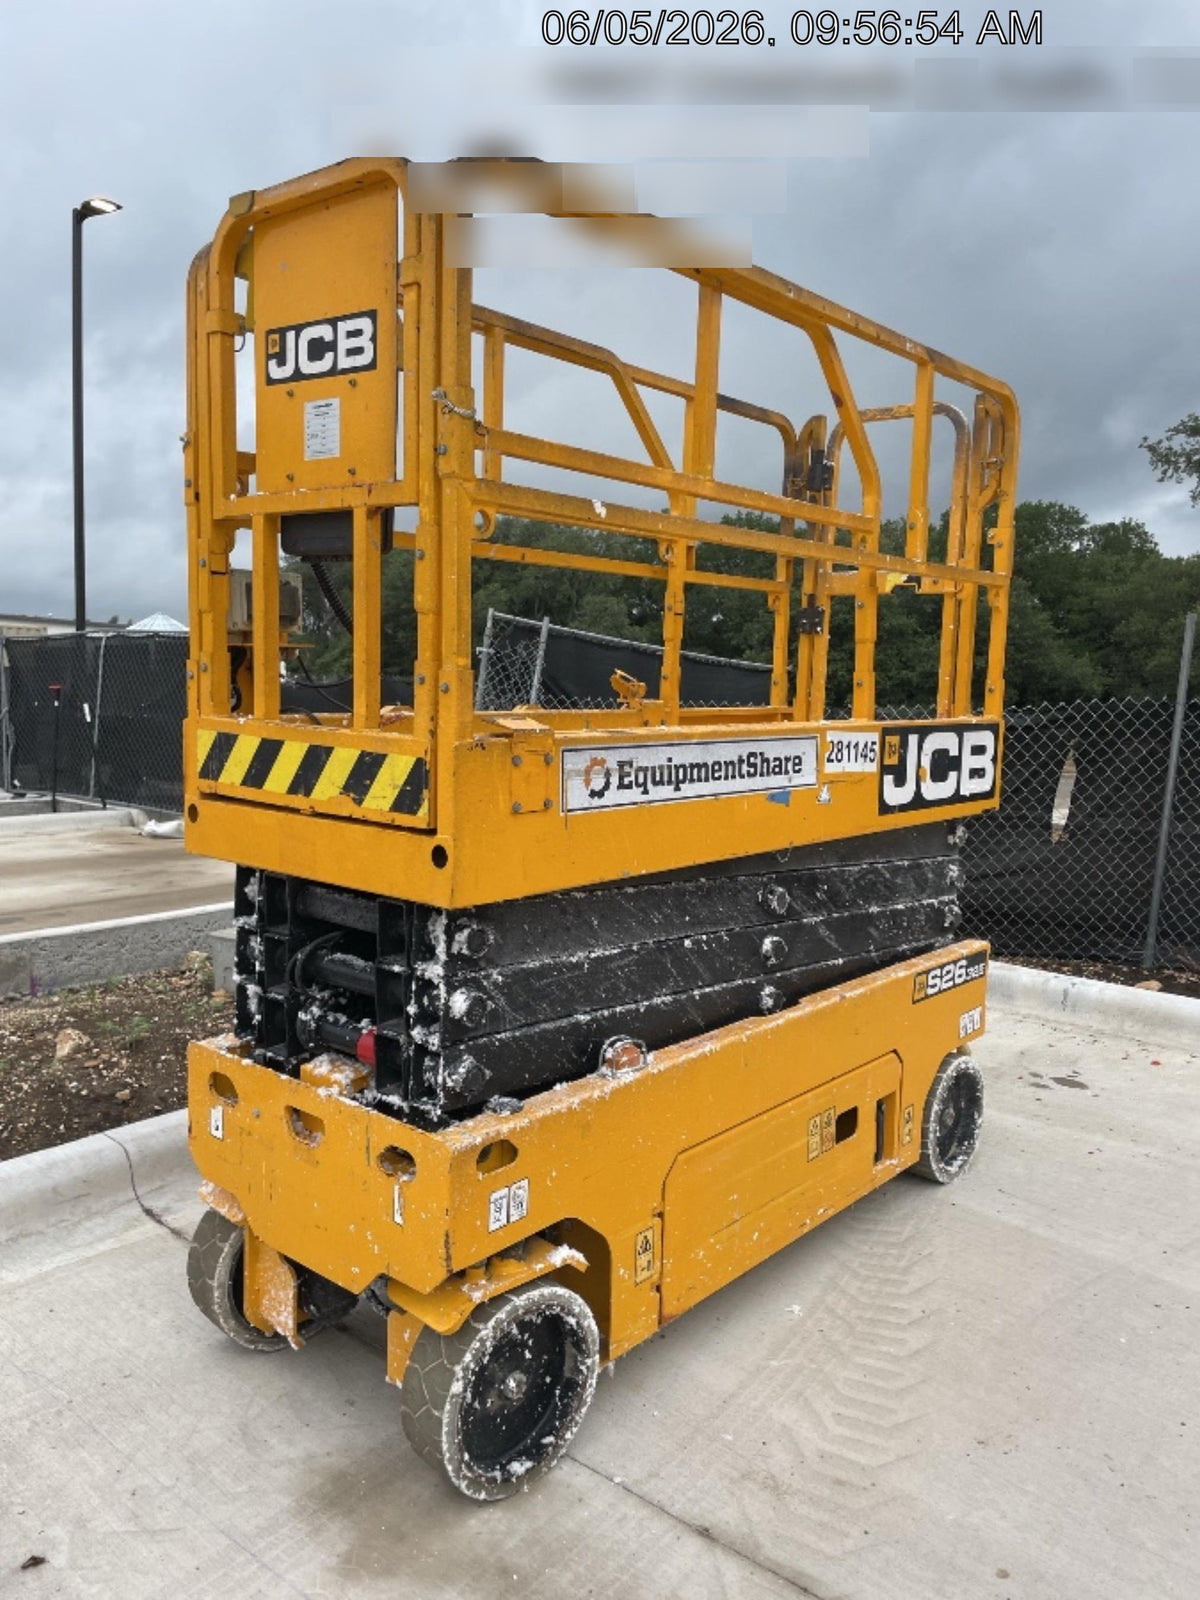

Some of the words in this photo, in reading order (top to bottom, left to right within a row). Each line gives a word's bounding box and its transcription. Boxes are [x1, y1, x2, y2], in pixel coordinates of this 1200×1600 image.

[267, 316, 375, 380] JCB
[616, 751, 803, 796] EquipmentShare
[826, 739, 878, 764] 281145
[883, 730, 995, 806] JCB
